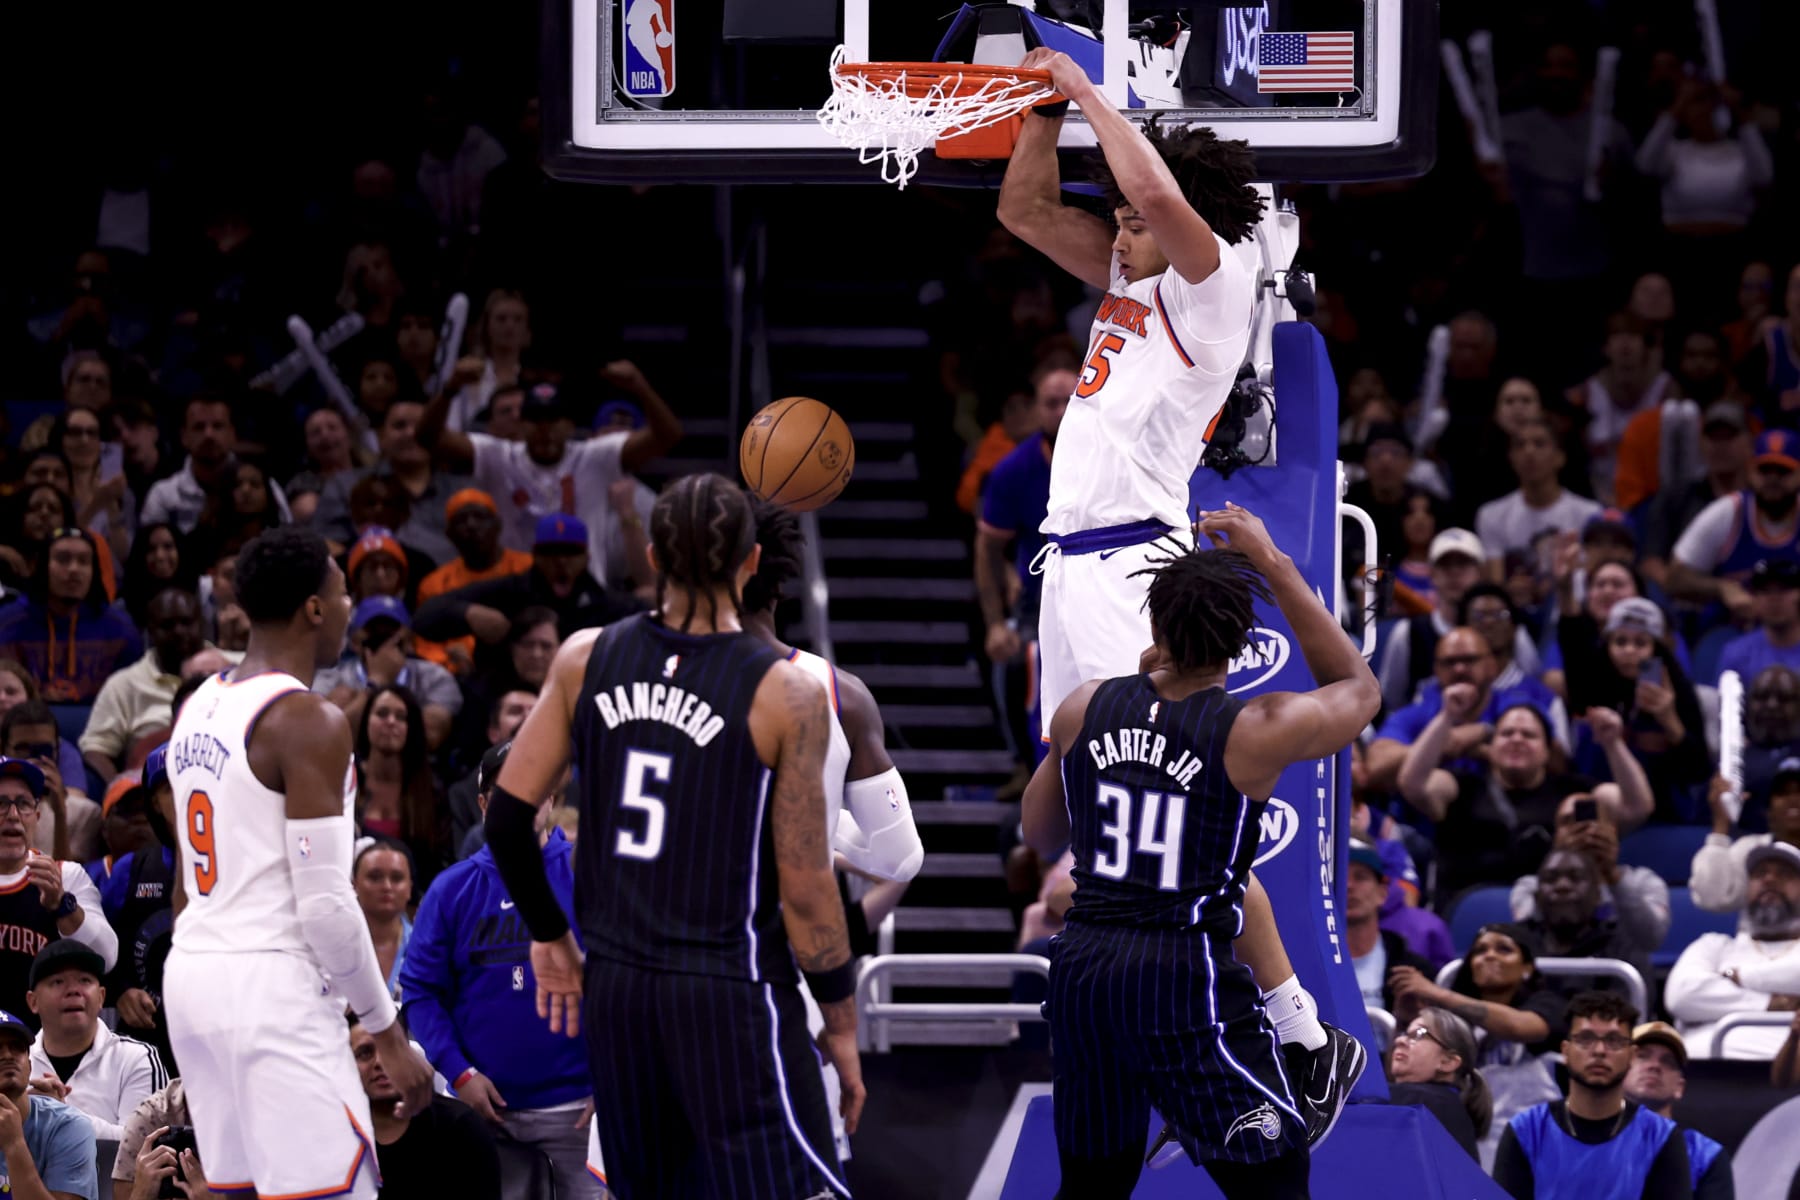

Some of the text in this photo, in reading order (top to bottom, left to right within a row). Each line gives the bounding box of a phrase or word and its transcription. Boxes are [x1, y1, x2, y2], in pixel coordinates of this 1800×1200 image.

[631, 71, 656, 90] NBA
[594, 682, 725, 747] BANCHERO
[175, 733, 231, 781] BARRETT
[1088, 728, 1203, 791] CARTER JR.
[615, 748, 674, 860] 5
[1094, 780, 1187, 891] 34
[187, 789, 218, 896] 9
[136, 882, 163, 898] NYC
